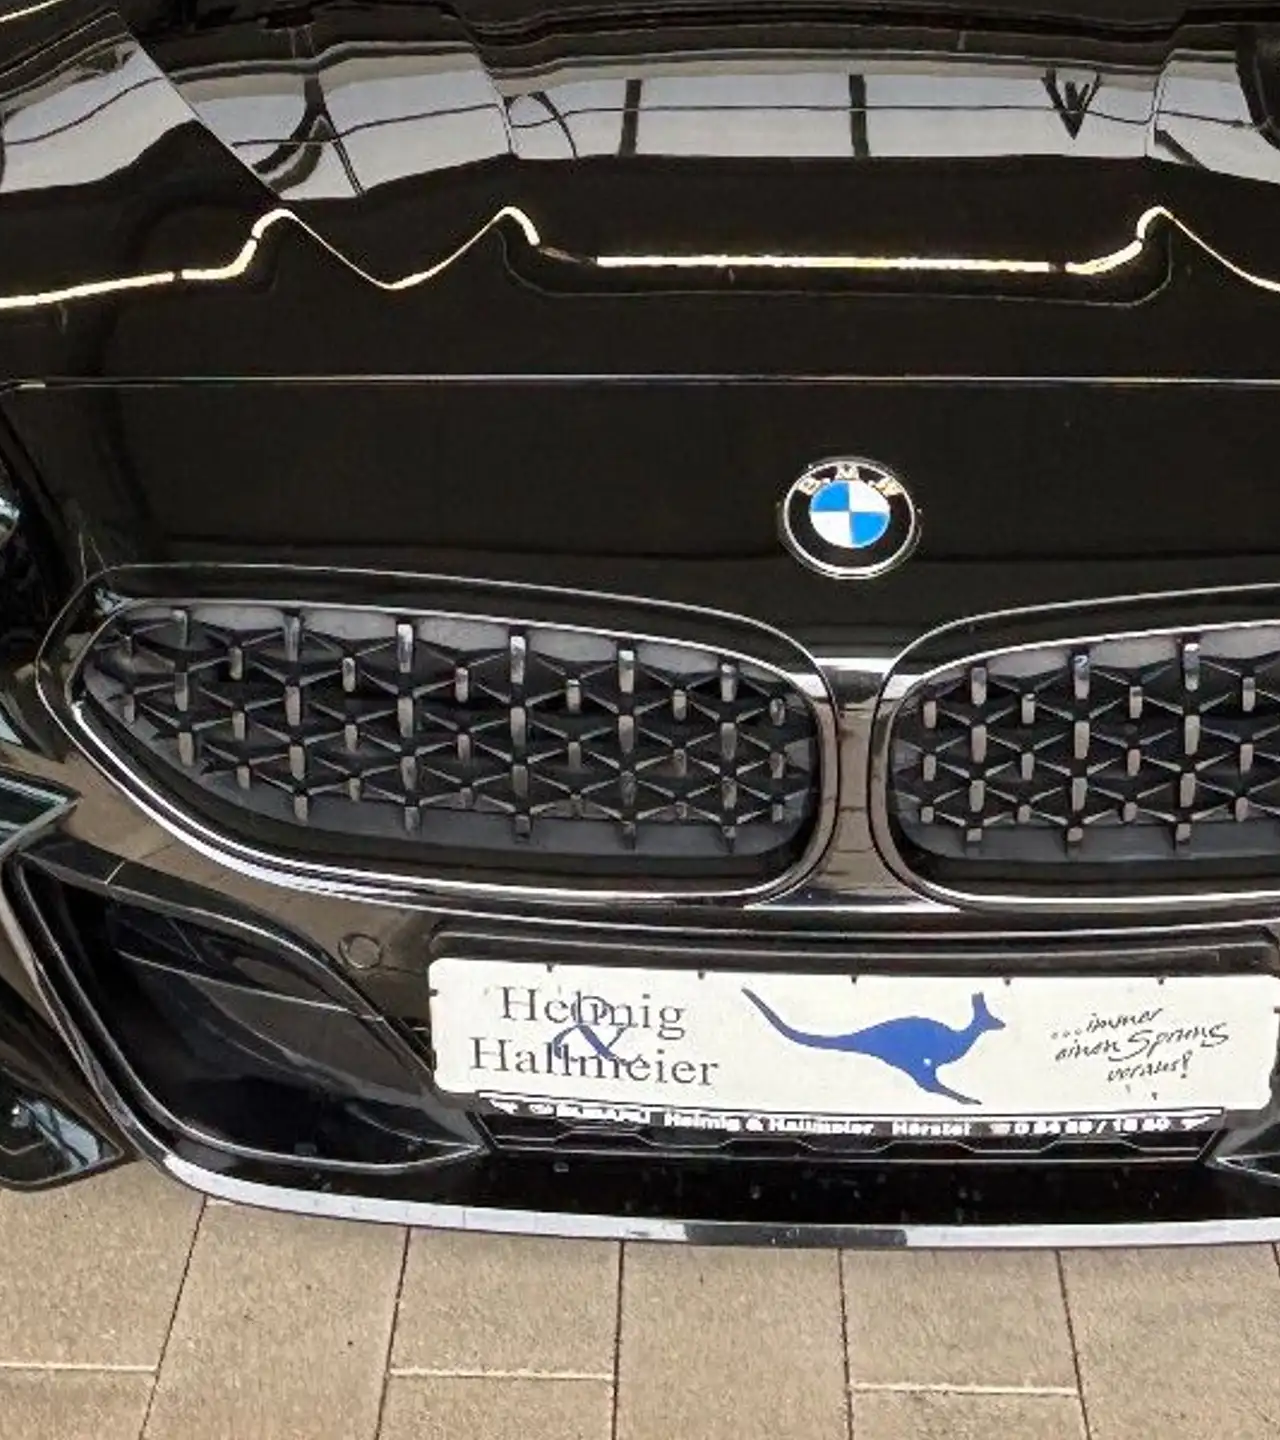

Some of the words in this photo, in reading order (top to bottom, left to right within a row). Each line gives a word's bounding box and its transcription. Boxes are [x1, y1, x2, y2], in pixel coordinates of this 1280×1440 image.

[798, 462, 904, 496] BMW
[500, 986, 685, 1040] Helmig
[551, 995, 632, 1064] &
[469, 1036, 719, 1086] Hallmeier
[1055, 1039, 1121, 1061] einen
[1107, 1022, 1229, 1062] Sprung
[1106, 1049, 1193, 1083] voraus!
